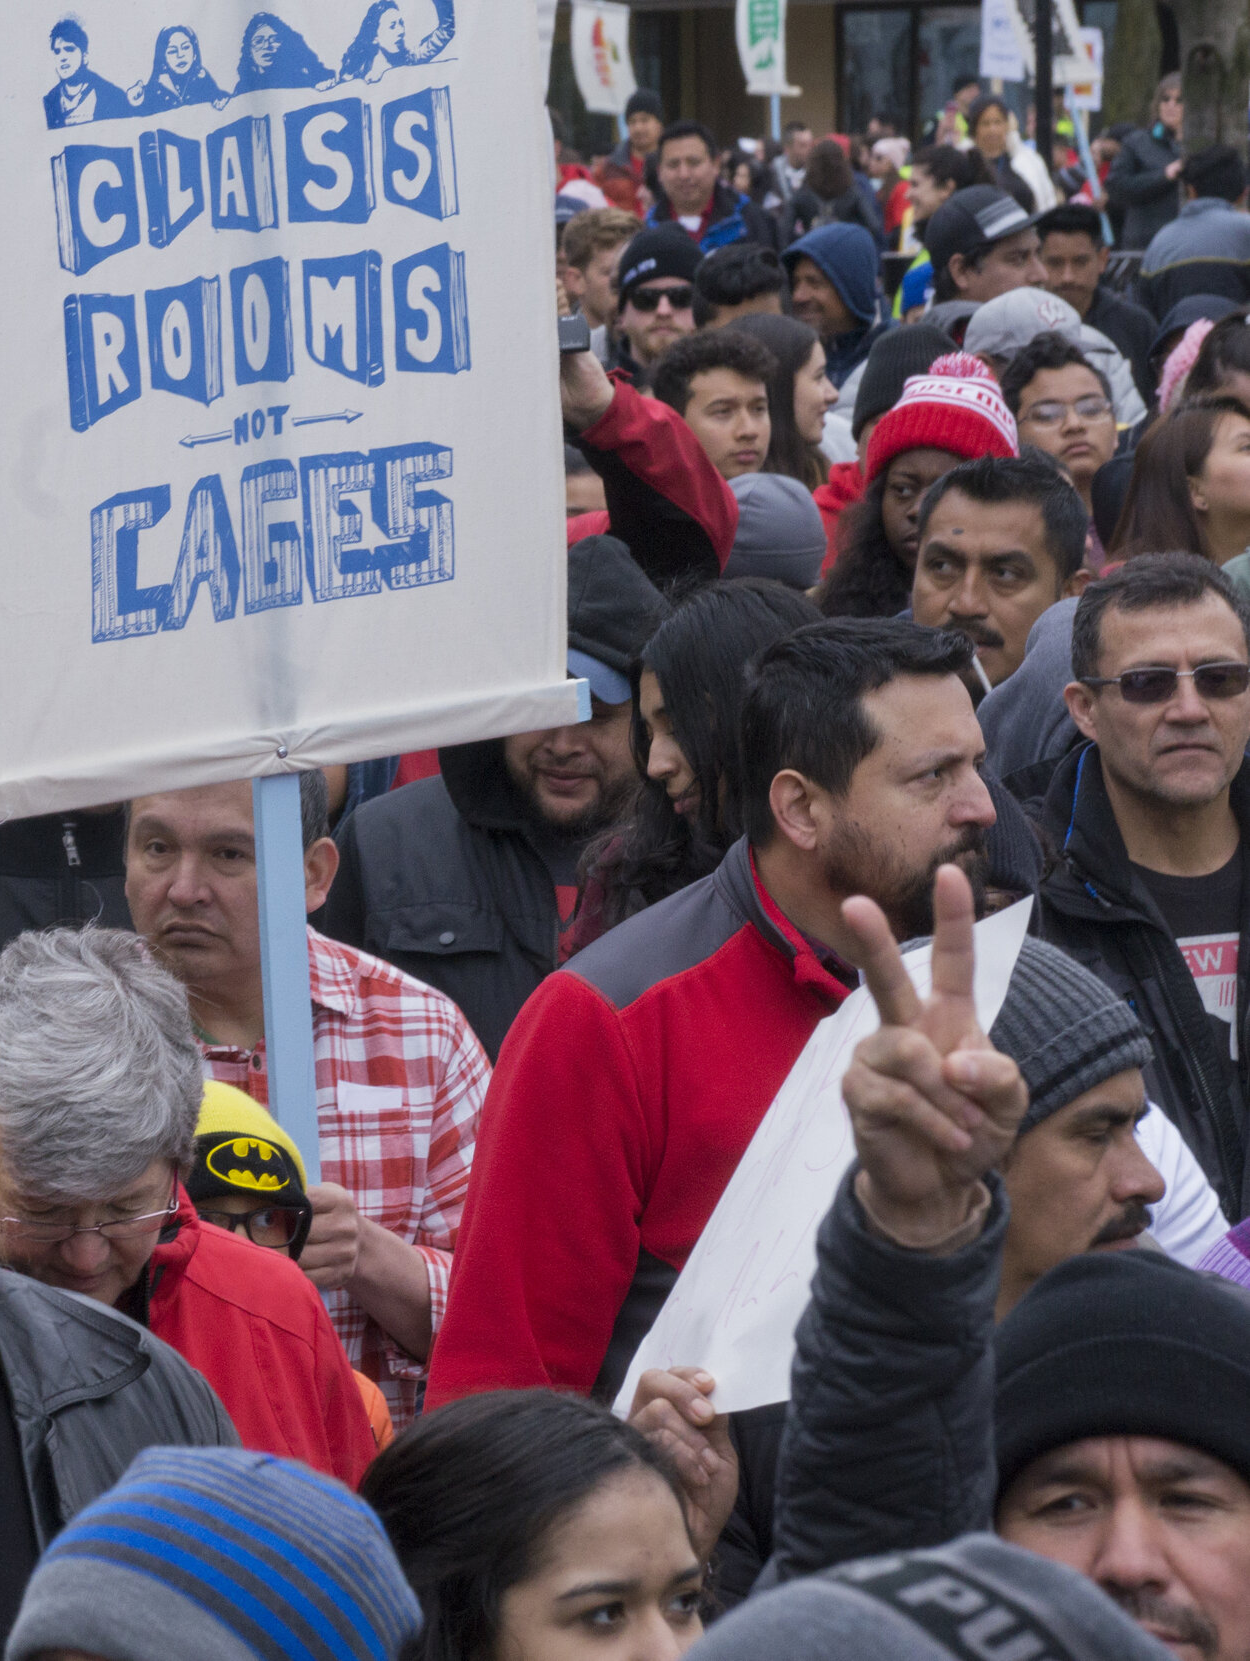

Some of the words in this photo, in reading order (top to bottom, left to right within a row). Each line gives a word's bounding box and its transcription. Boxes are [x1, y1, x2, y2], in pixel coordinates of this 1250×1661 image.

[76, 110, 432, 248] CLASS
[91, 265, 444, 407] ROOMS
[234, 404, 291, 447] NOT
[90, 441, 454, 644] CAGES
